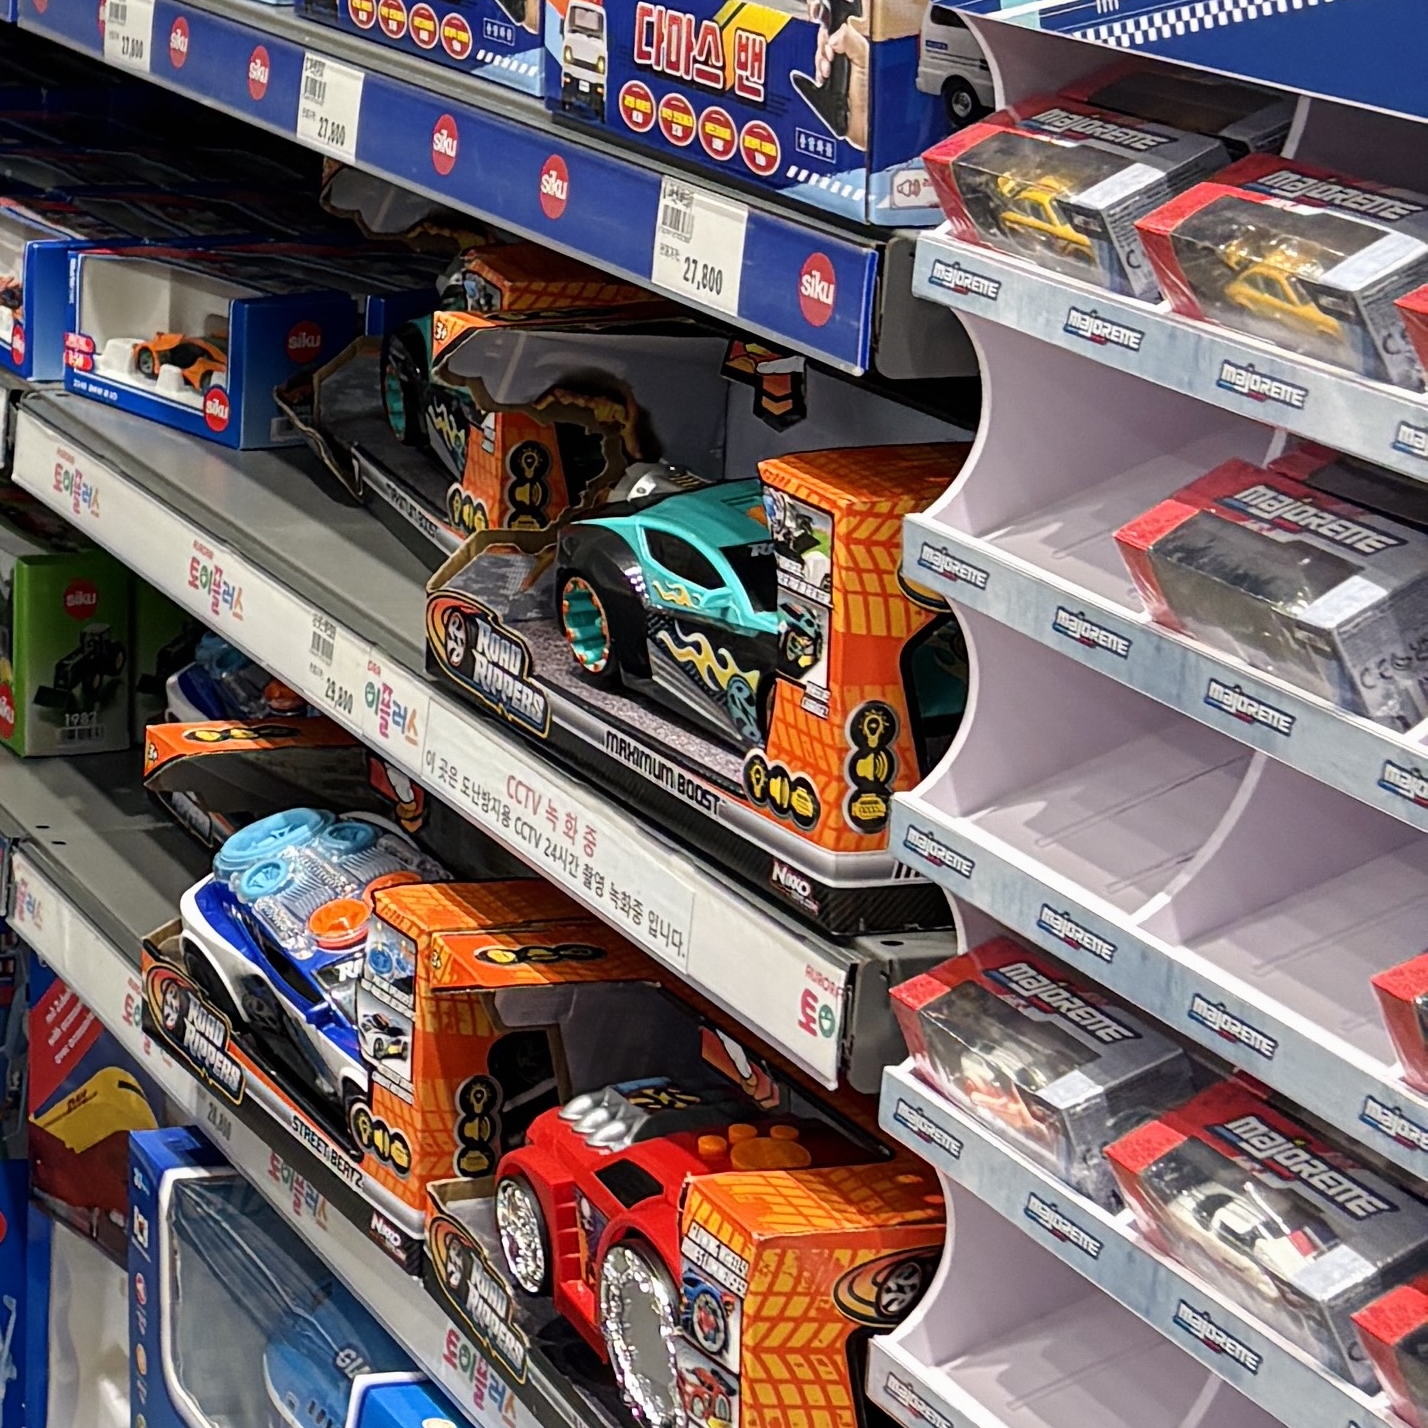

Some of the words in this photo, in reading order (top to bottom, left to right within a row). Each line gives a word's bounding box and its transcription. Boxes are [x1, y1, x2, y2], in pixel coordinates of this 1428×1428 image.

[633, 0, 725, 90] 다마스
[735, 27, 767, 102] 밴
[541, 170, 567, 201] siku
[683, 256, 724, 296] 27,800
[801, 272, 834, 305] siku
[472, 658, 545, 724] RIPPERS
[605, 730, 675, 789] MAXIMUM
[677, 772, 722, 817] BOOST
[513, 814, 543, 854] CCTV
[544, 837, 581, 879] 24시간
